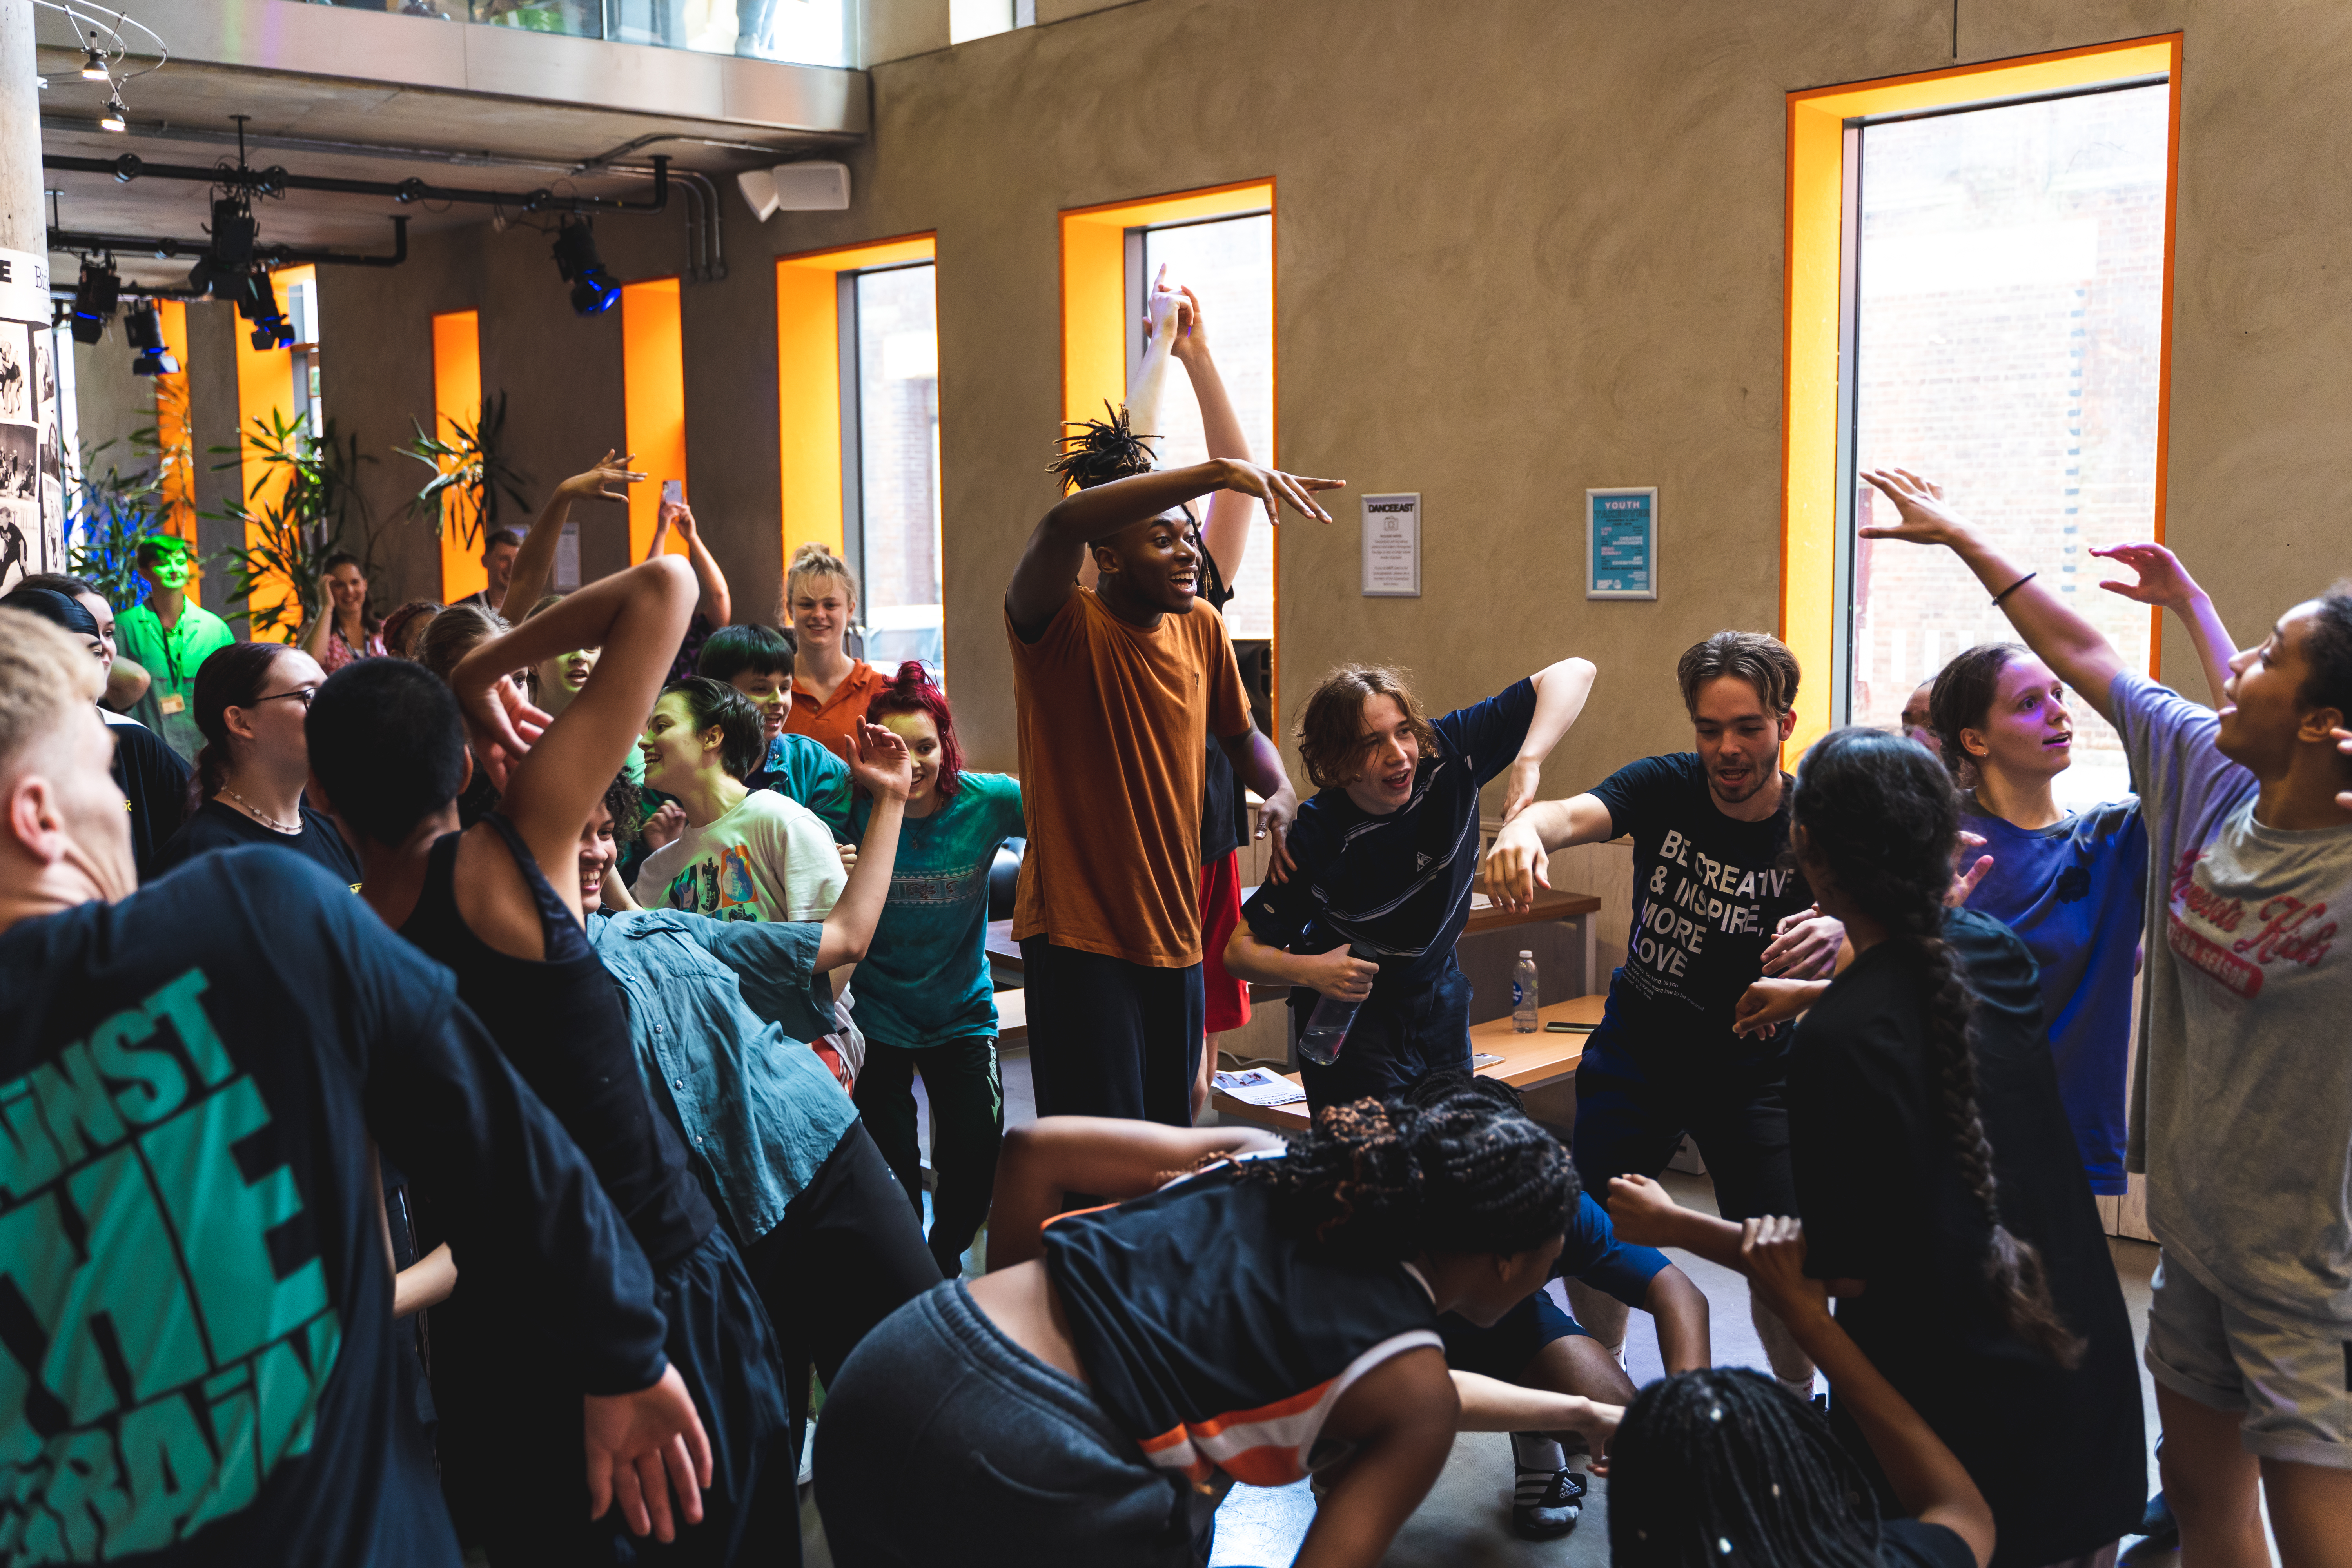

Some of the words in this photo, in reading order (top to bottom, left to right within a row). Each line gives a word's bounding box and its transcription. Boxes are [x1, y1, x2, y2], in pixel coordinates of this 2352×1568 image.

[1369, 503, 1414, 513] DANCEEAST
[1605, 501, 1640, 509] YOUTH
[1659, 829, 1691, 868] BE
[1650, 866, 1668, 895] &
[1673, 877, 1764, 937] INSPIRE,
[1641, 896, 1707, 954] MORE
[1632, 925, 1688, 978] LOVE
[1631, 966, 1639, 976] world
[1640, 975, 1651, 986] needs
[1652, 985, 1663, 993] more
[1687, 997, 1704, 1011] inspired
[1639, 982, 1654, 995] yourself
[1651, 976, 1662, 985] kind,
[1643, 991, 1651, 1000] love
[0, 966, 234, 1201] iNST
[1559, 1486, 1581, 1498] adidas
